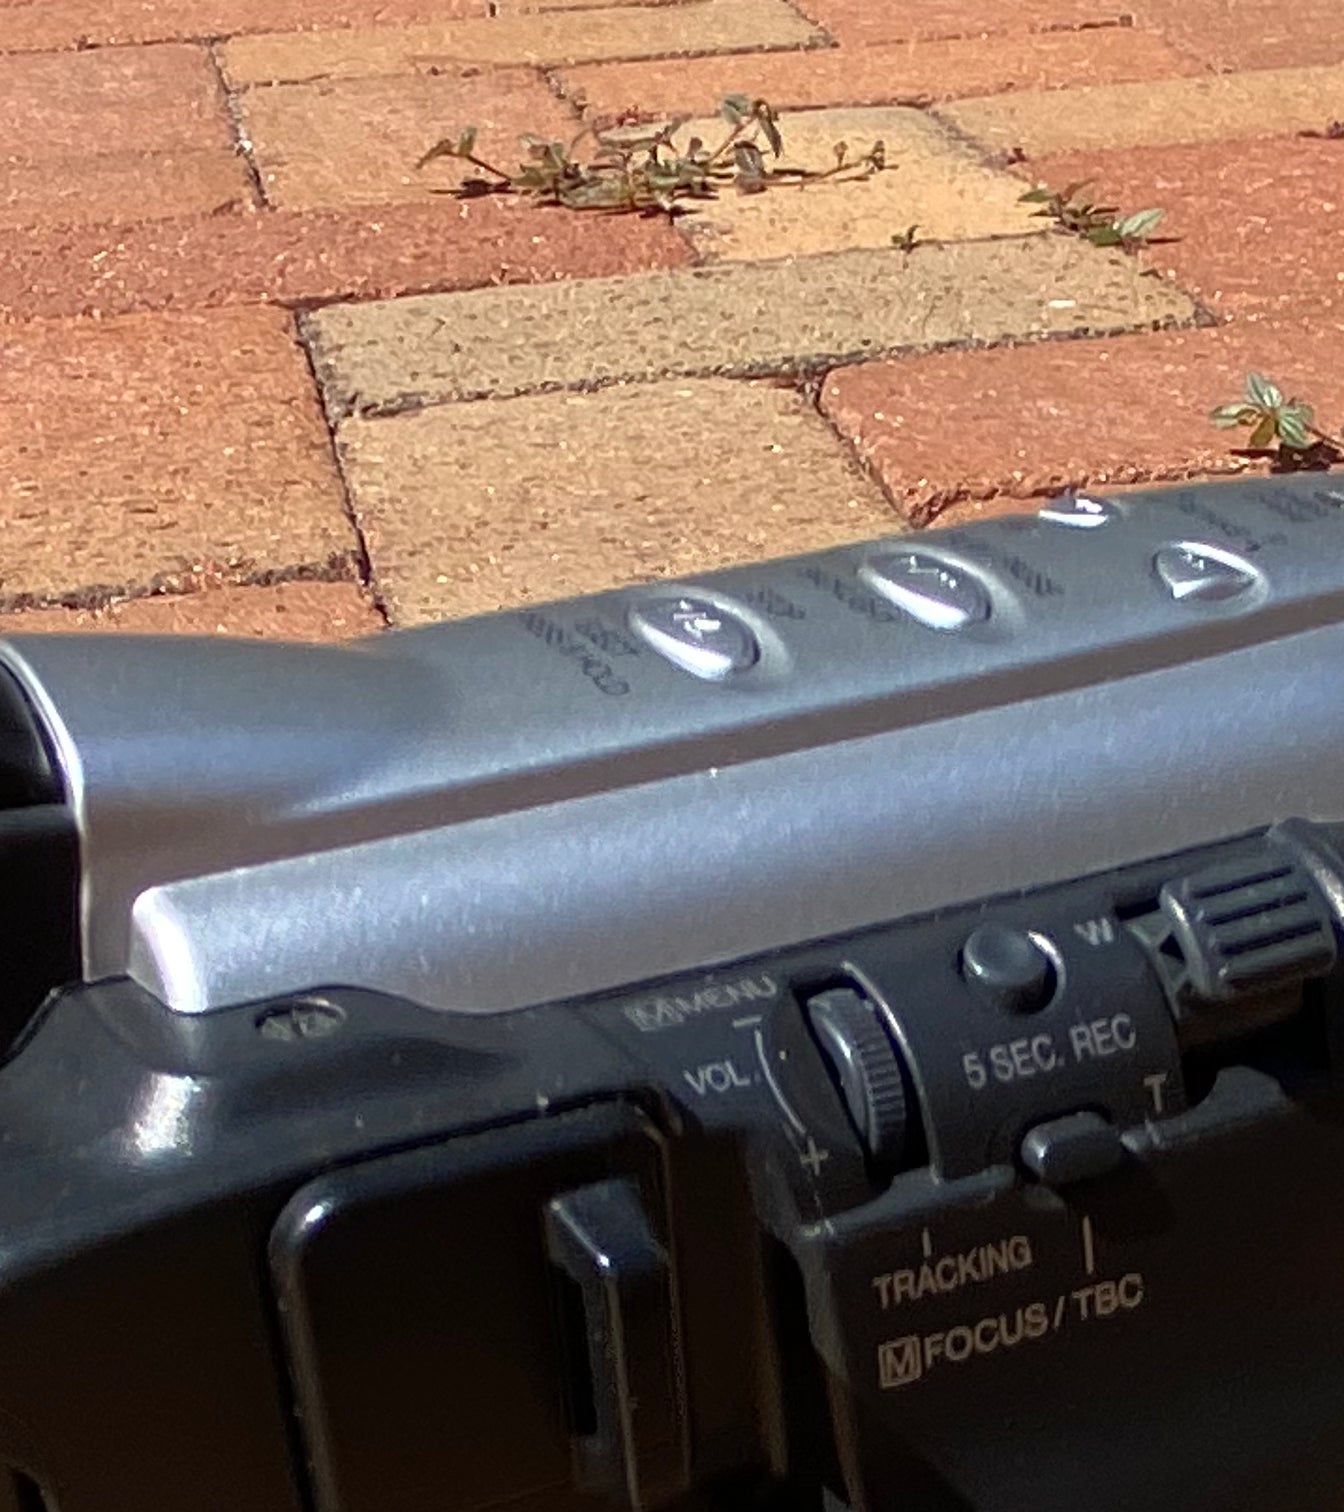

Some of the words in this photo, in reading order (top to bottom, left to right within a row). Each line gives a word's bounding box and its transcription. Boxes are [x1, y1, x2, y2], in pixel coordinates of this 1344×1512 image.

[963, 1051, 987, 1089] 5
[990, 1033, 1065, 1082] SEC.
[1069, 1012, 1136, 1062] REC
[1144, 1073, 1168, 1113] T
[872, 1235, 1032, 1309] TRACKING
